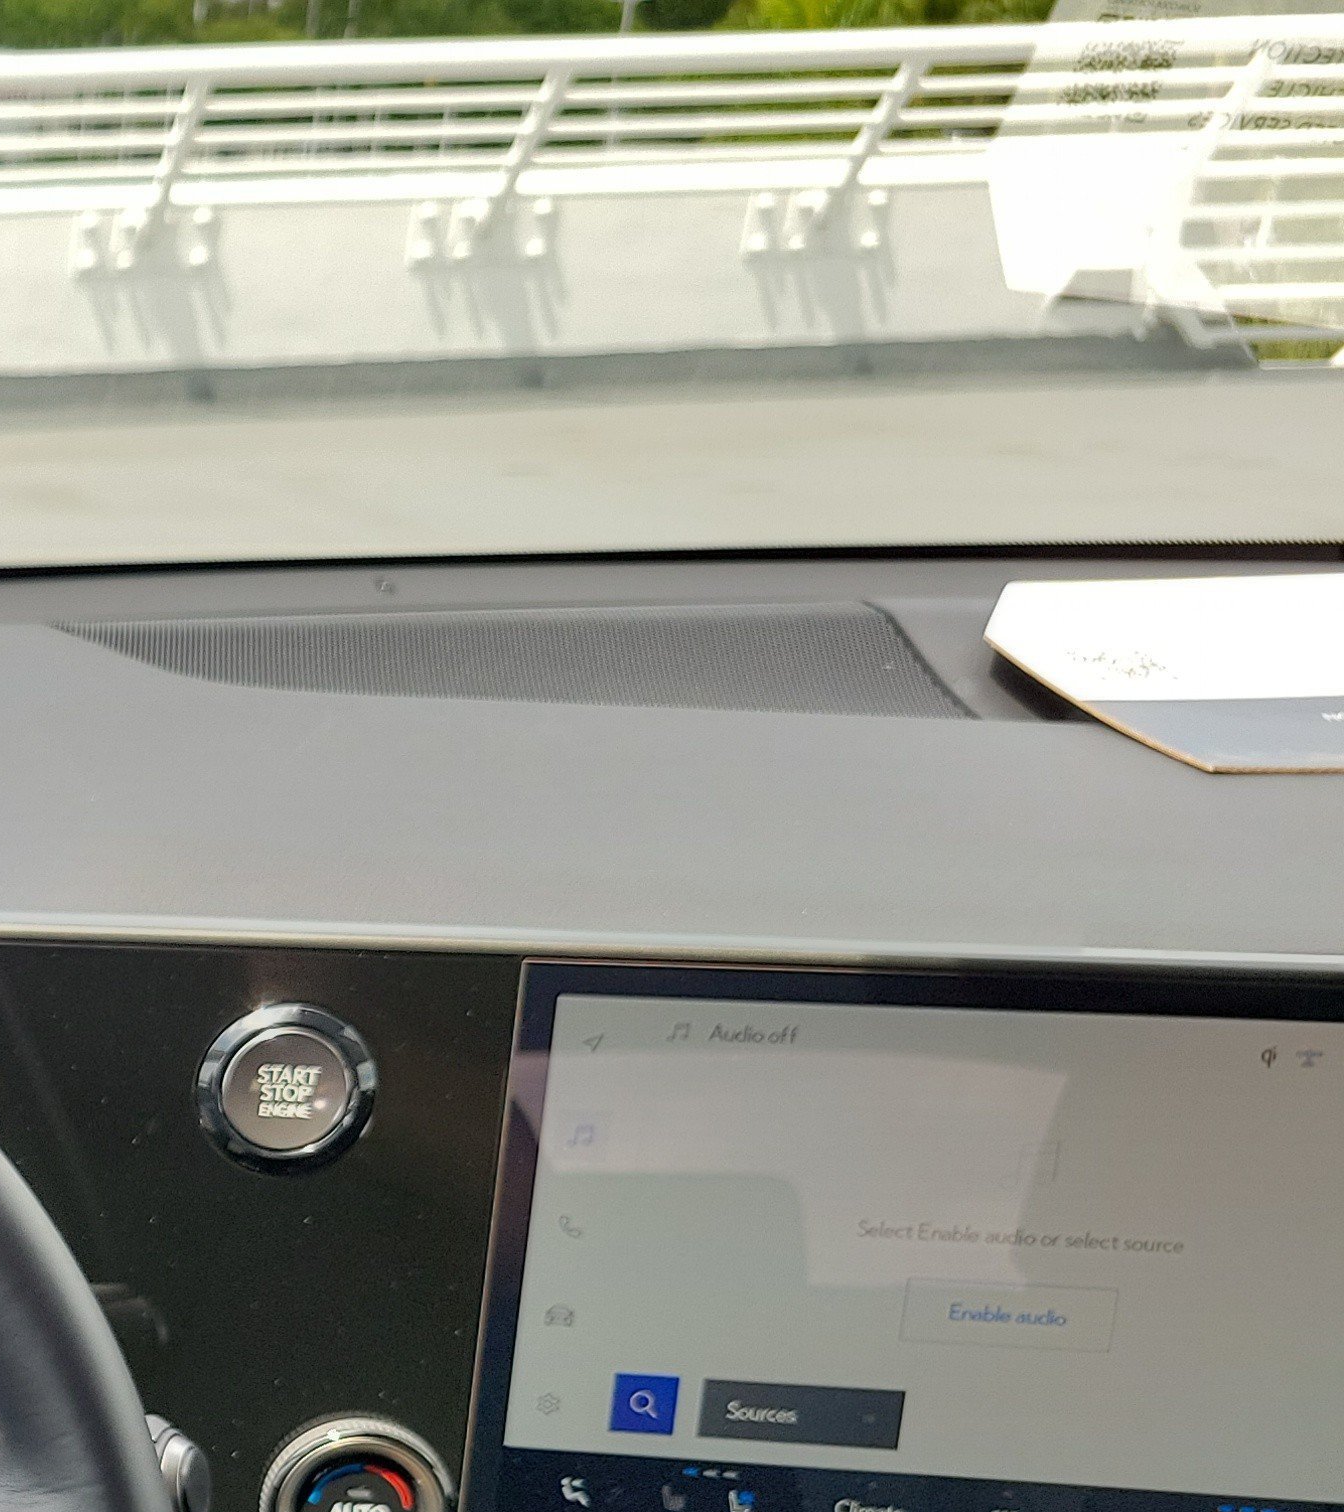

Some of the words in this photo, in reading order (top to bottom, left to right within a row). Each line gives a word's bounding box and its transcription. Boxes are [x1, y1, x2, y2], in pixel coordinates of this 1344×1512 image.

[709, 1022, 763, 1044] Audio
[767, 1024, 800, 1045] off
[257, 1064, 322, 1085] START
[260, 1084, 312, 1101] STOP
[257, 1101, 312, 1120] ENGINE
[857, 1219, 913, 1240] Select
[917, 1221, 979, 1243] Enable
[985, 1227, 1036, 1247] audio
[1040, 1235, 1059, 1247] or
[1065, 1231, 1119, 1251] select
[1123, 1237, 1185, 1255] source
[947, 1301, 1011, 1325] Enable
[1015, 1306, 1067, 1327] audio
[725, 1400, 798, 1425] Sources
